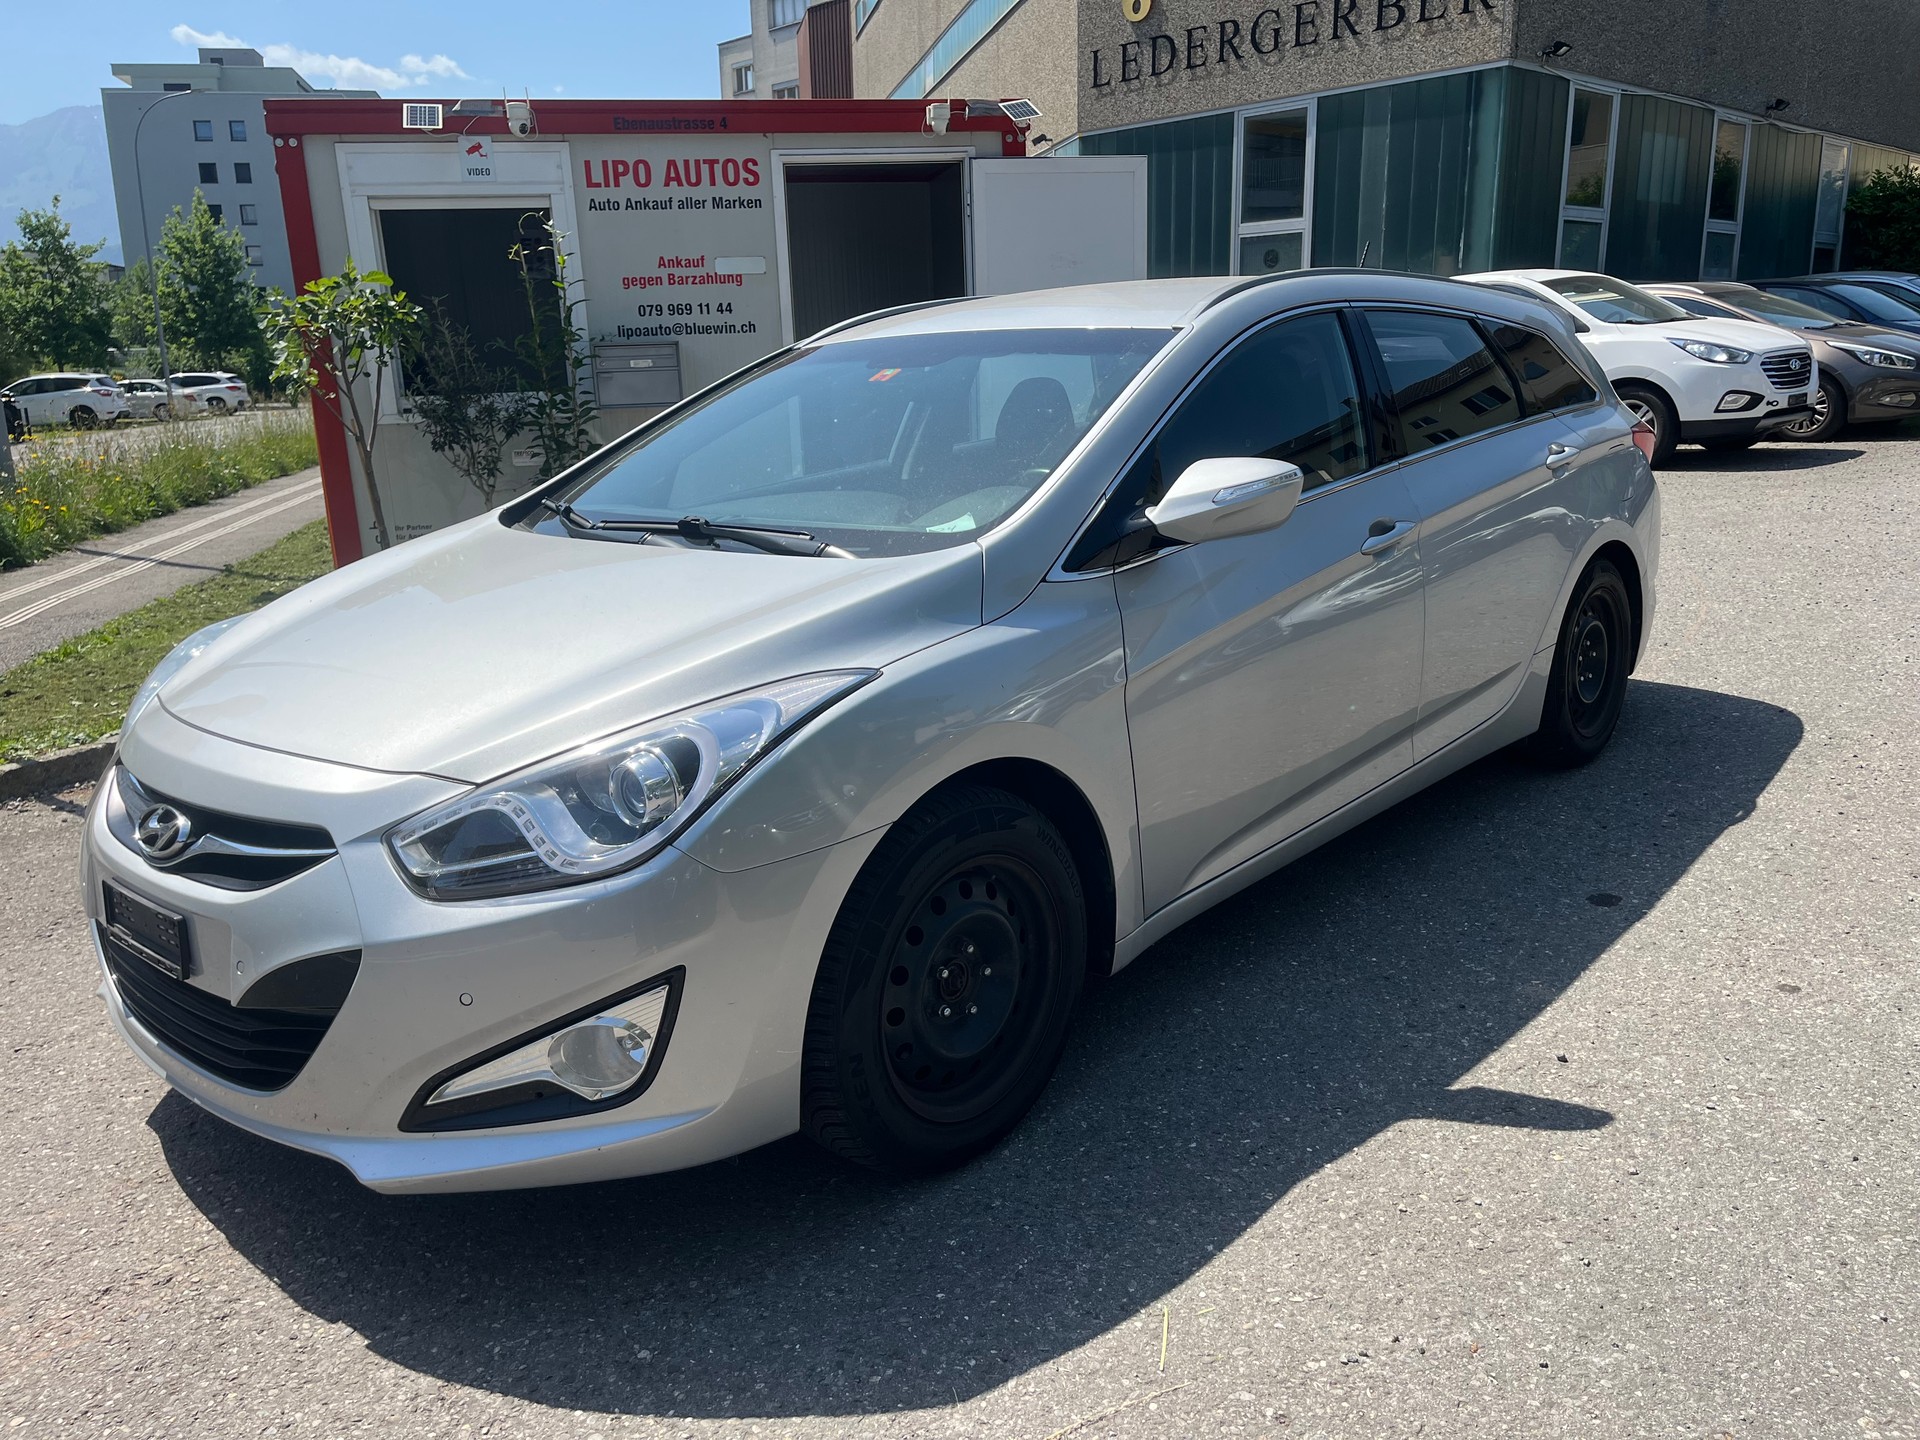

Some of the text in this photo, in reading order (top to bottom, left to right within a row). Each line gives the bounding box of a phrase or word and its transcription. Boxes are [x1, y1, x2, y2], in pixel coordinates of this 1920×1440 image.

[613, 116, 728, 131] Ebenaustrasse 4
[466, 167, 491, 176] VIDEO
[584, 157, 761, 189] LIPO AUTOS
[588, 196, 762, 212] Auto Ankauf aller Marken
[658, 255, 706, 269] Ankauf
[622, 272, 743, 290] gegen Barzahlung
[638, 302, 733, 317] 079 969 11 44
[617, 320, 756, 340] lipoauto@bluewin.ch
[406, 523, 433, 531] Partner
[1036, 823, 1081, 898] WINGUARD
